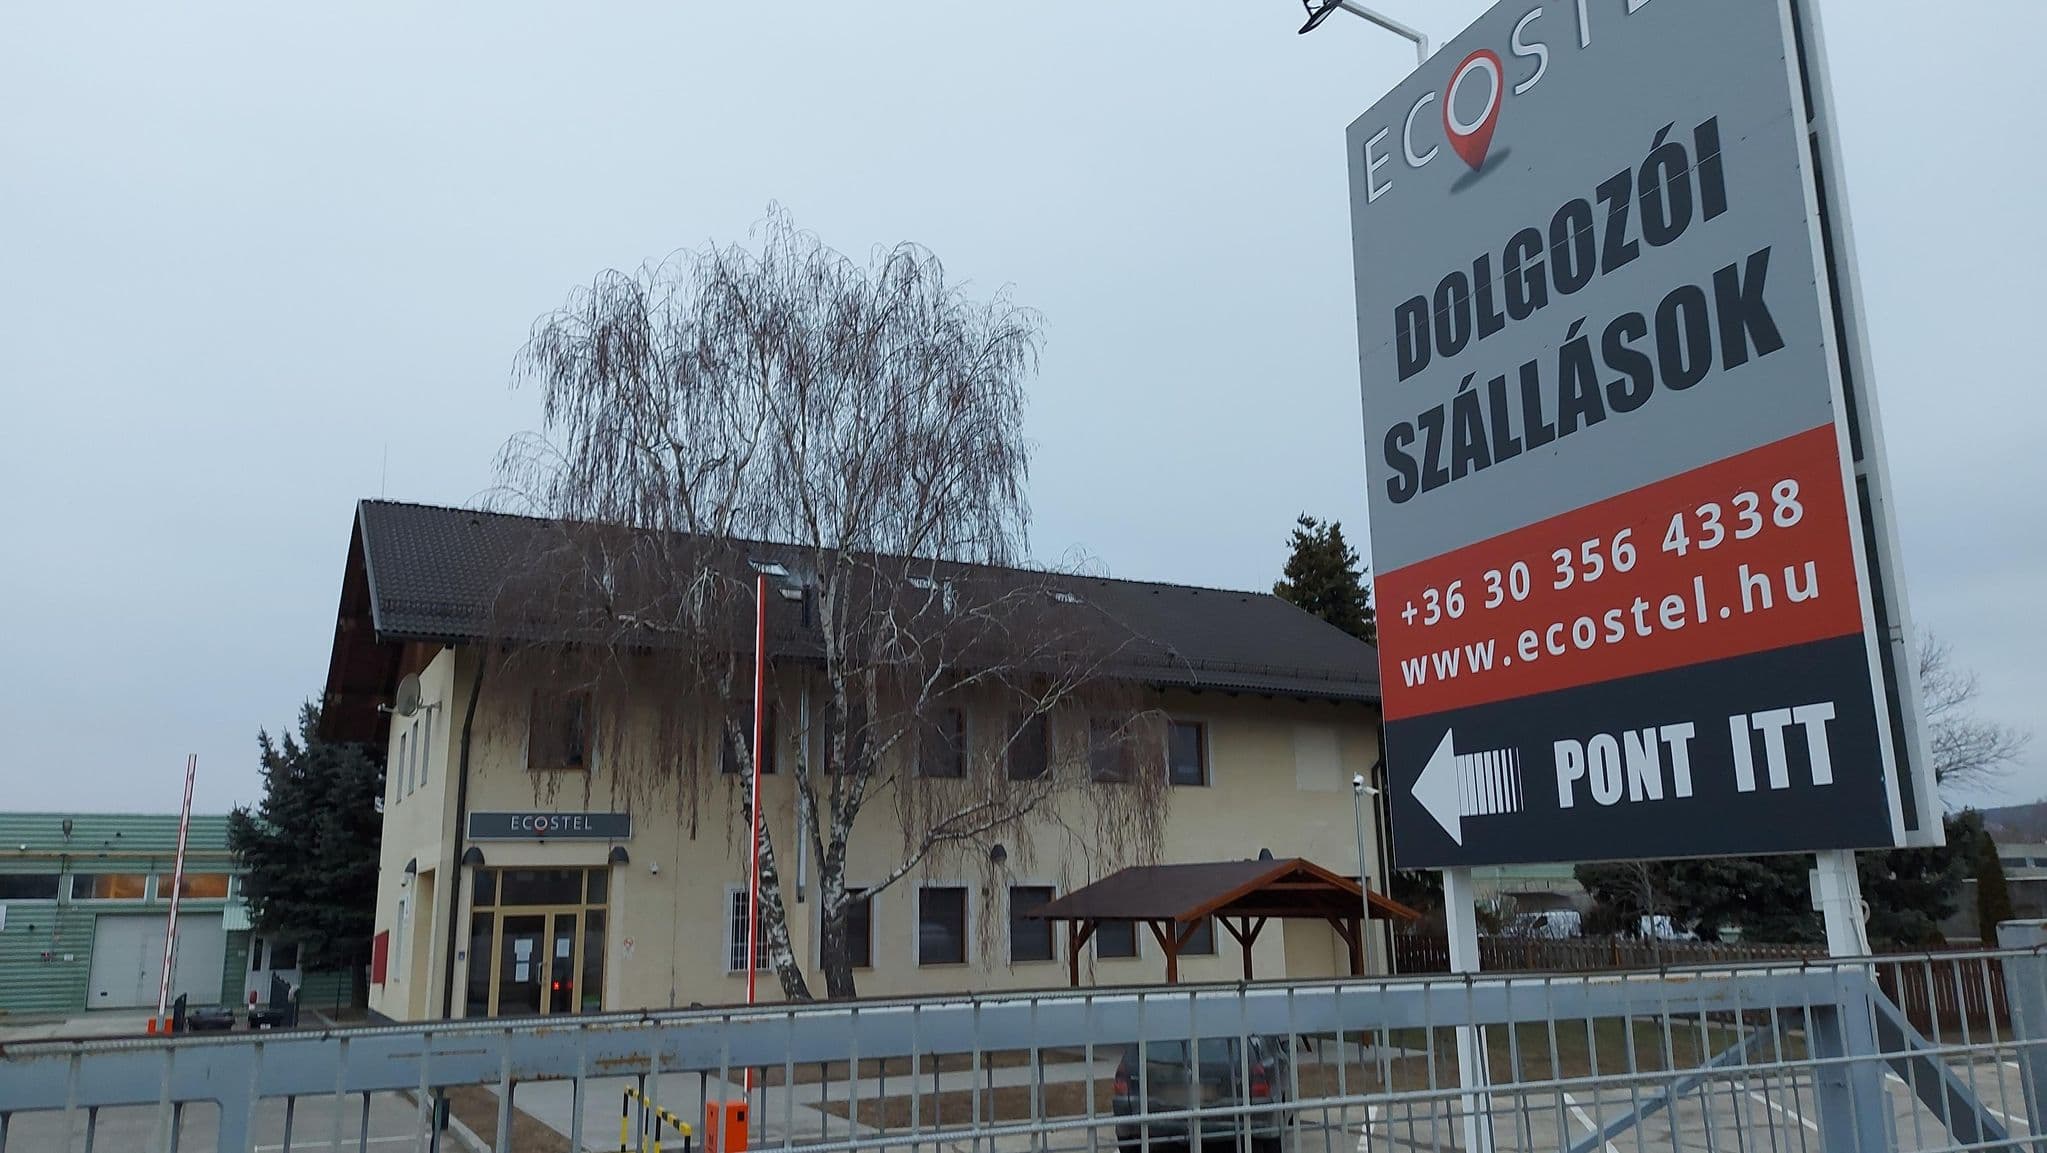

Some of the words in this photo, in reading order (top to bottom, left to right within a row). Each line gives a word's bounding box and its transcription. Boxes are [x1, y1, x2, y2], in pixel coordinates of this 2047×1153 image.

[1394, 115, 1728, 383] DOLGOZÓI
[1383, 245, 1786, 505] SZÁLLÁSOK
[1401, 580, 1465, 627] +36
[1483, 561, 1531, 610] 30
[1551, 527, 1637, 591] 356
[1662, 479, 1804, 558] 4338
[1400, 560, 1820, 688] www.ecostel.hu
[511, 815, 593, 832] ECOSTEL
[1553, 721, 1695, 809] PONT
[1729, 701, 1836, 793] ITT
